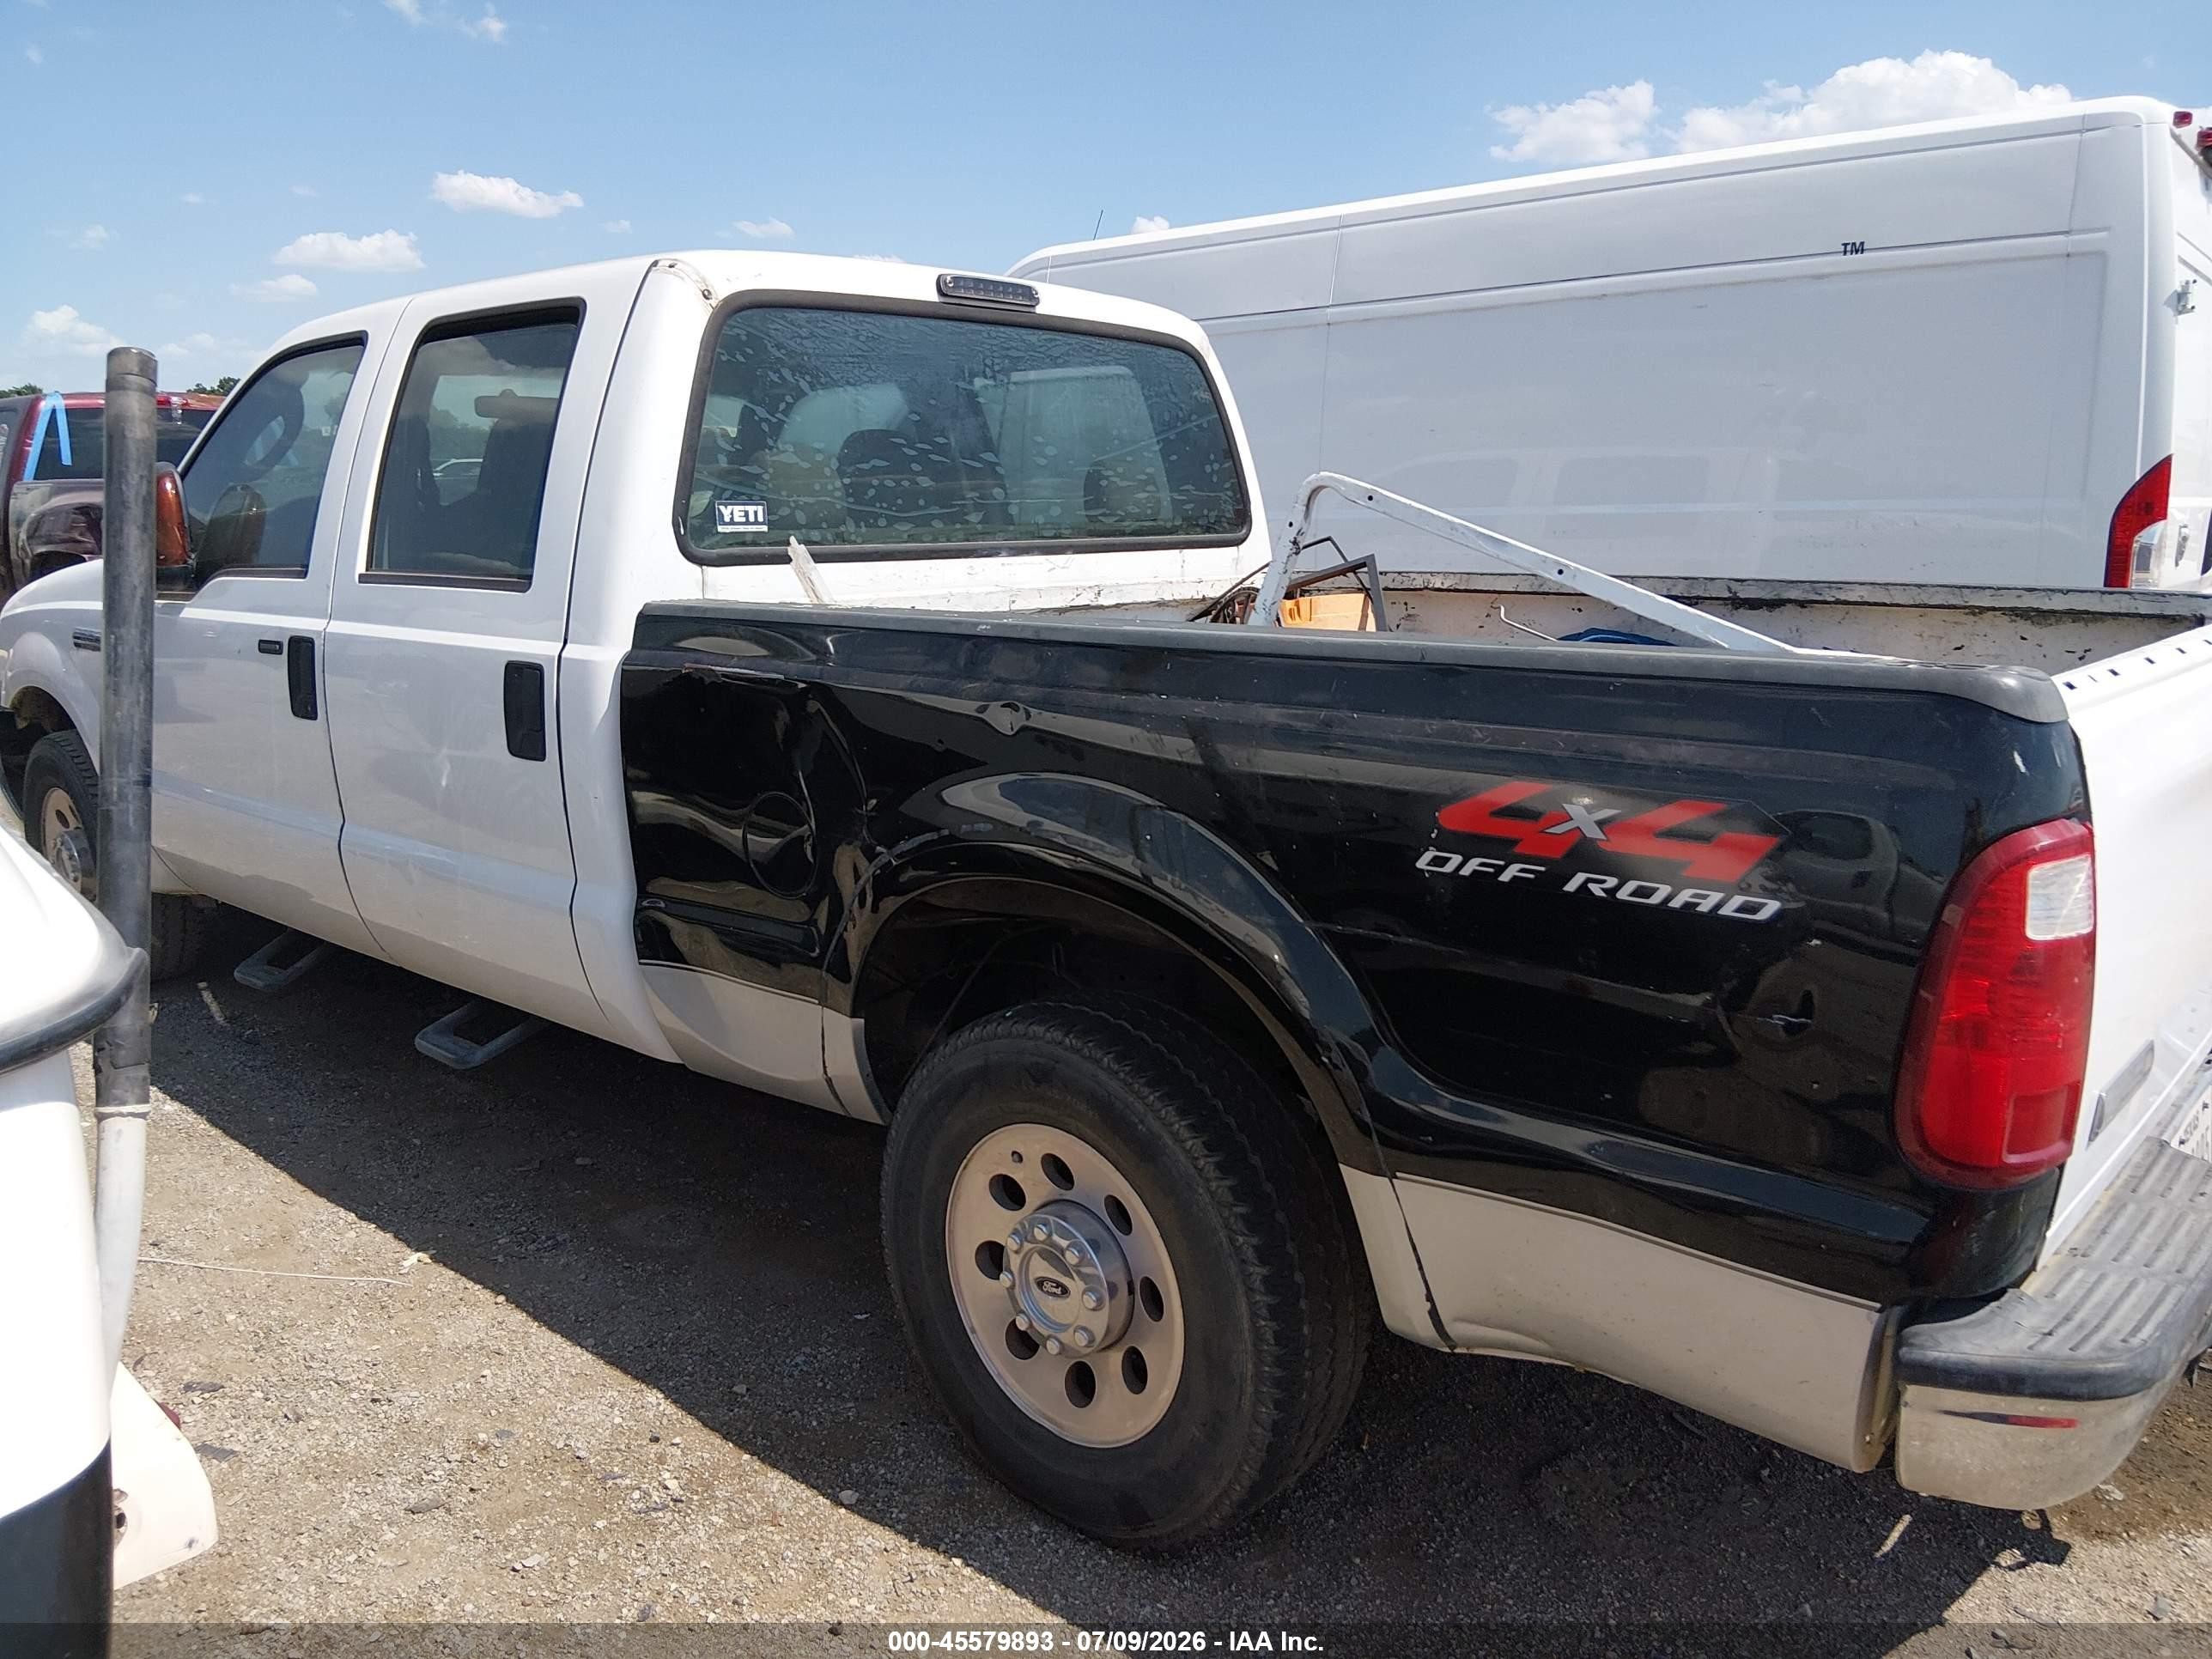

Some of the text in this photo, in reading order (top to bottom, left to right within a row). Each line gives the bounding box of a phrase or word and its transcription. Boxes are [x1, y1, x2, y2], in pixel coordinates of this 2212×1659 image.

[1841, 240, 1865, 257] TM
[718, 505, 764, 523] YETI
[1415, 849, 1783, 921] OFF ROAD
[1042, 1280, 1061, 1295] Ford
